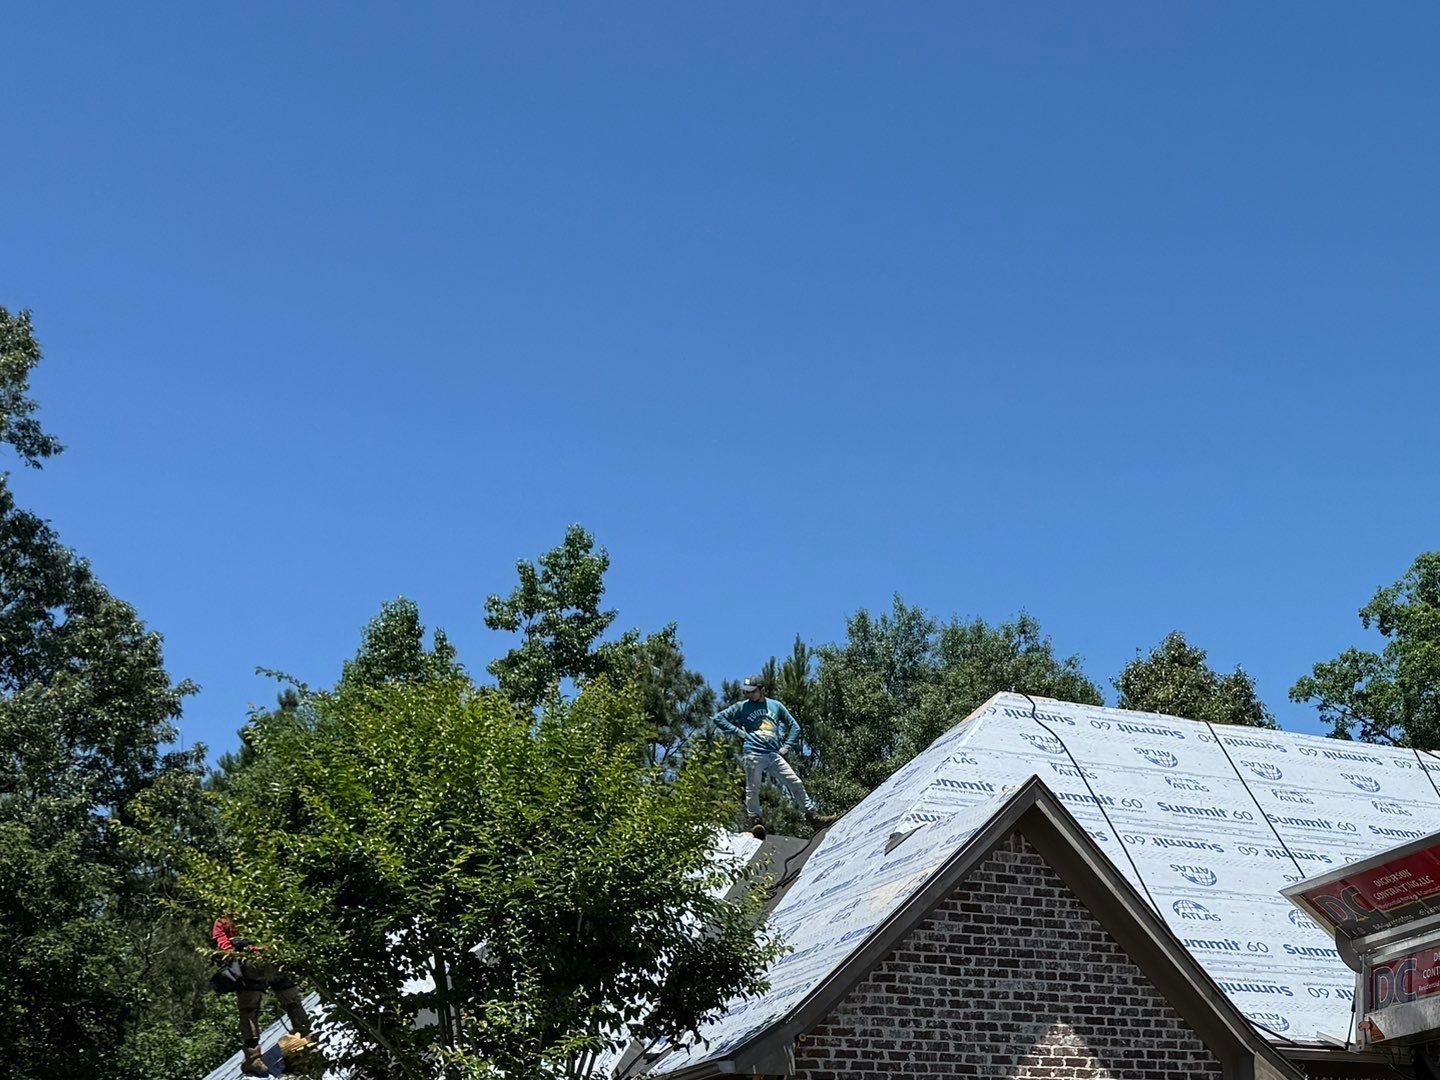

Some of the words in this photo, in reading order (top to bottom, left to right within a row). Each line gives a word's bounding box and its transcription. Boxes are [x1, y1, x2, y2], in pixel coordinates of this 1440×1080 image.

[1004, 707, 1076, 726] Summit
[1090, 719, 1111, 731] 60
[1117, 722, 1185, 740] Summit
[1019, 732, 1065, 746] ATLAS
[1198, 733, 1218, 745] 60
[1223, 736, 1288, 753] Summit
[1133, 746, 1173, 759] ATLAS
[1299, 747, 1318, 758] 60
[1322, 749, 1384, 766] Summit
[1240, 759, 1277, 772] ATLAS
[1394, 758, 1412, 769] 60
[1059, 767, 1098, 780] ATLAS
[1340, 772, 1375, 784] ATLAS
[1172, 782, 1210, 793] ATLAS
[1052, 791, 1116, 807] ummit
[1121, 797, 1144, 810] 60
[1279, 793, 1315, 805] ATLAS
[1156, 800, 1229, 819] Summit
[1232, 809, 1254, 821] 60
[1379, 805, 1413, 817] ATLAS
[1265, 813, 1332, 830] Summit
[1337, 820, 1357, 833] 60
[1123, 833, 1146, 846] 60
[1151, 836, 1225, 853] Summit
[1237, 844, 1259, 856] 60
[1264, 848, 1333, 864] Summit
[1170, 863, 1213, 875] ATLAS
[1373, 868, 1412, 888] DICKERSON
[1181, 911, 1222, 922] ATLAS
[1246, 941, 1270, 954] 60
[1373, 957, 1419, 1011] DC
[1307, 986, 1330, 999] 60
